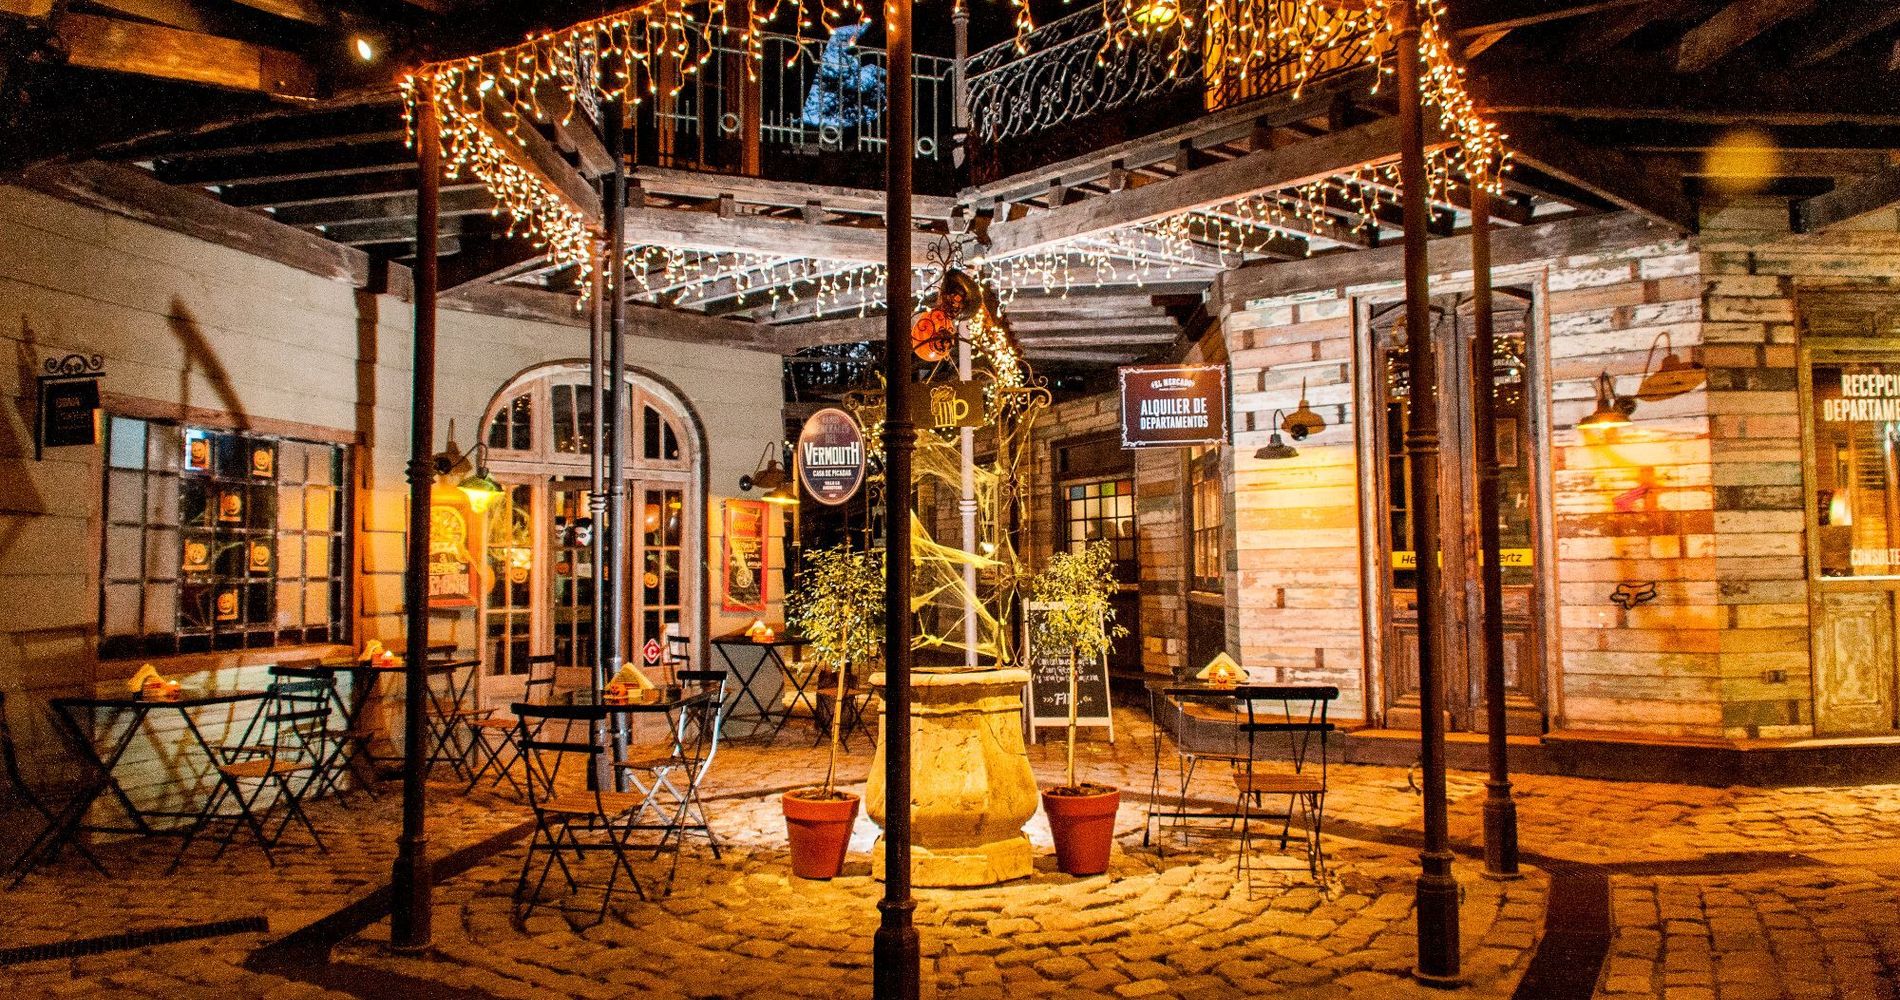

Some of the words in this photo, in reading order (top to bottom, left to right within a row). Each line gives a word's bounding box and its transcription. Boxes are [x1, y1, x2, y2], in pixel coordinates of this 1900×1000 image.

[1841, 374, 1900, 397] RECEPCI
[1140, 398, 1190, 416] ALQUILER
[1193, 397, 1207, 414] DE
[1140, 415, 1208, 430] DEPARTAMENTOS
[1500, 553, 1522, 562] ertz
